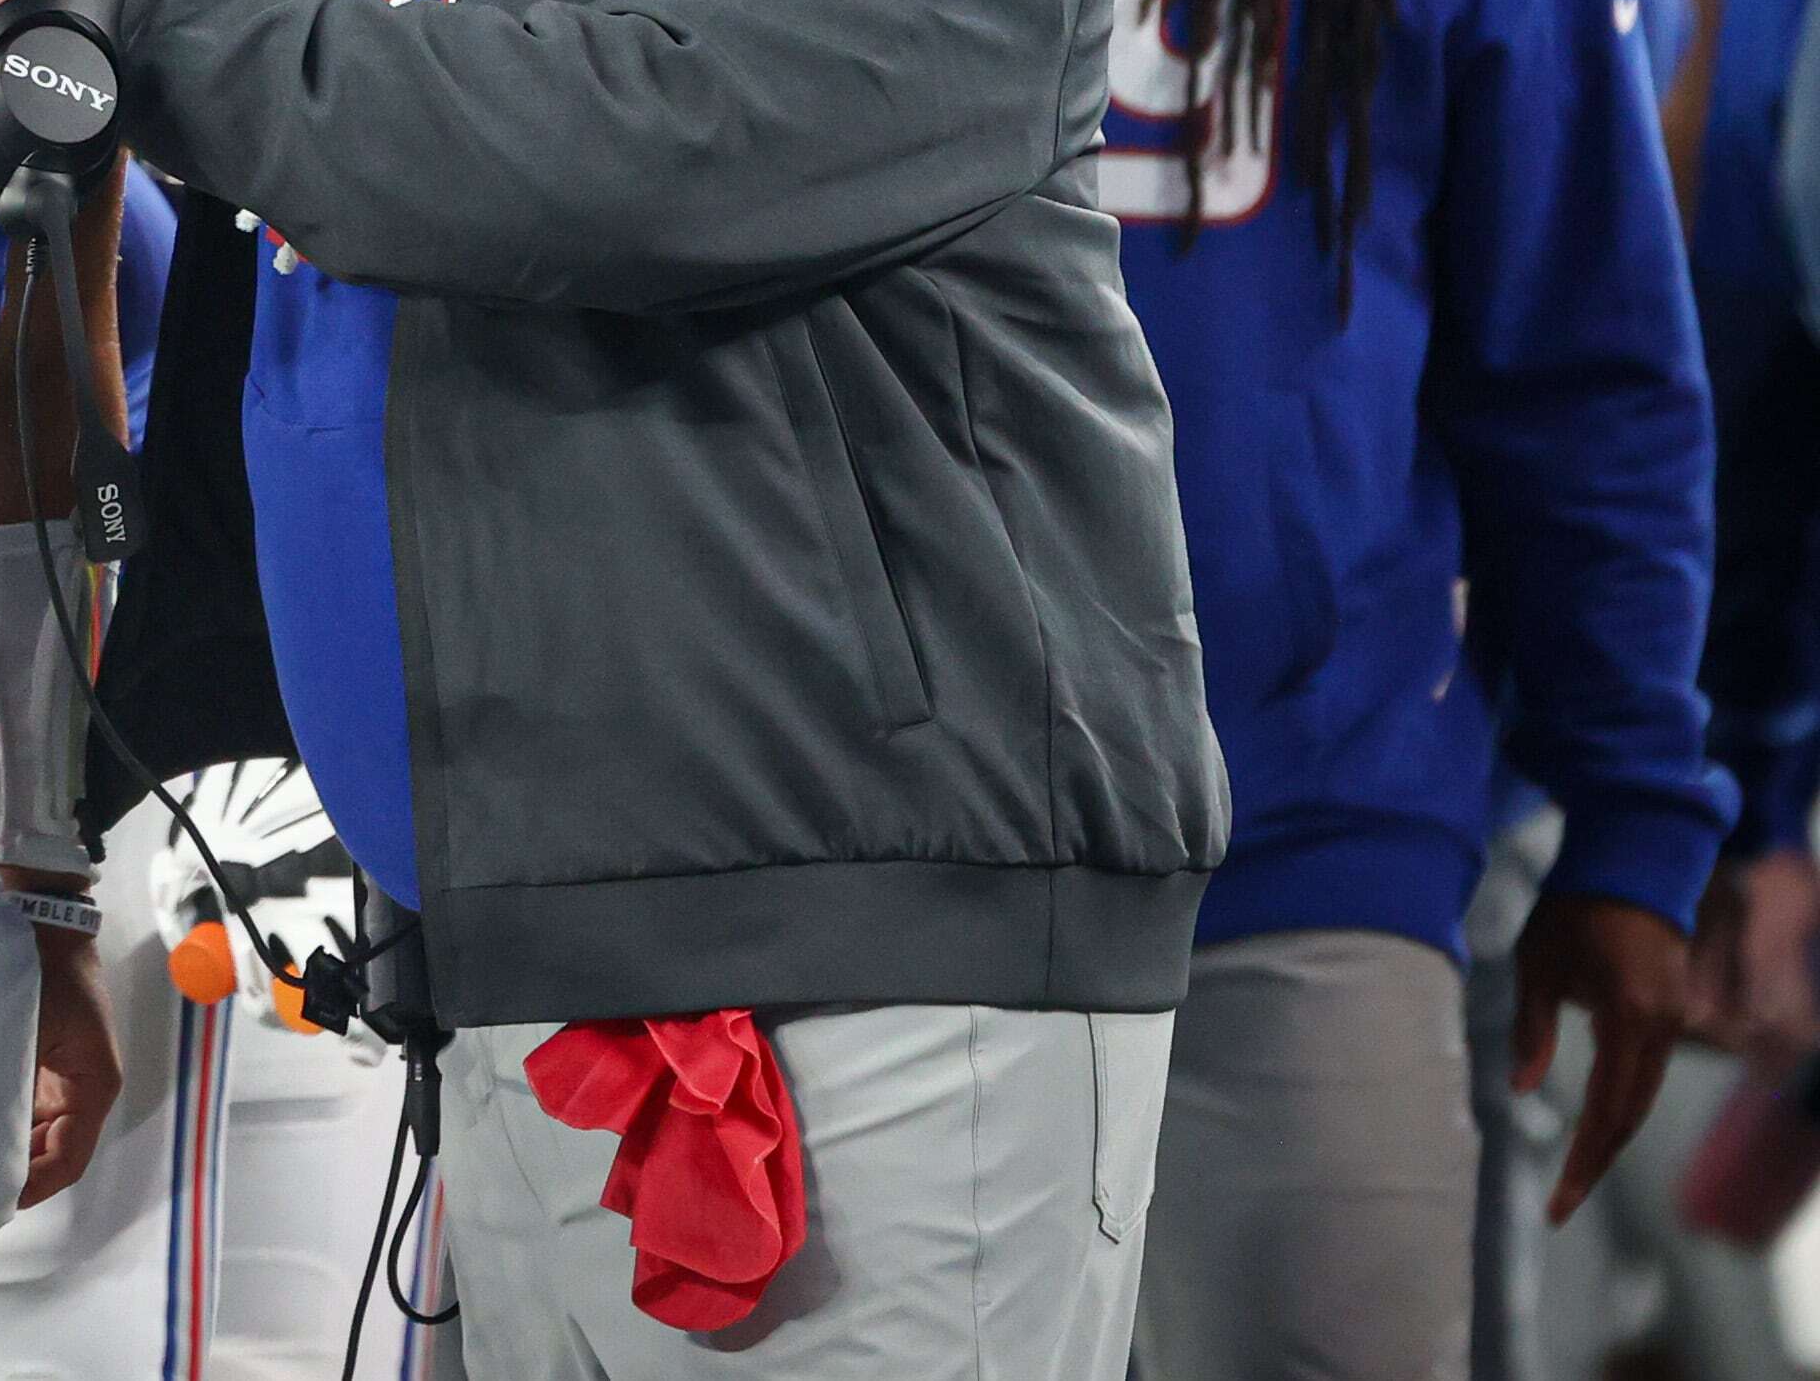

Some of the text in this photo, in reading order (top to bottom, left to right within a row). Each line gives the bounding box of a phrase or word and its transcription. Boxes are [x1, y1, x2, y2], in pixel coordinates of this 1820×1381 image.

[3, 54, 115, 111] SONY
[97, 483, 127, 543] SONY
[16, 898, 75, 923] MBLE
